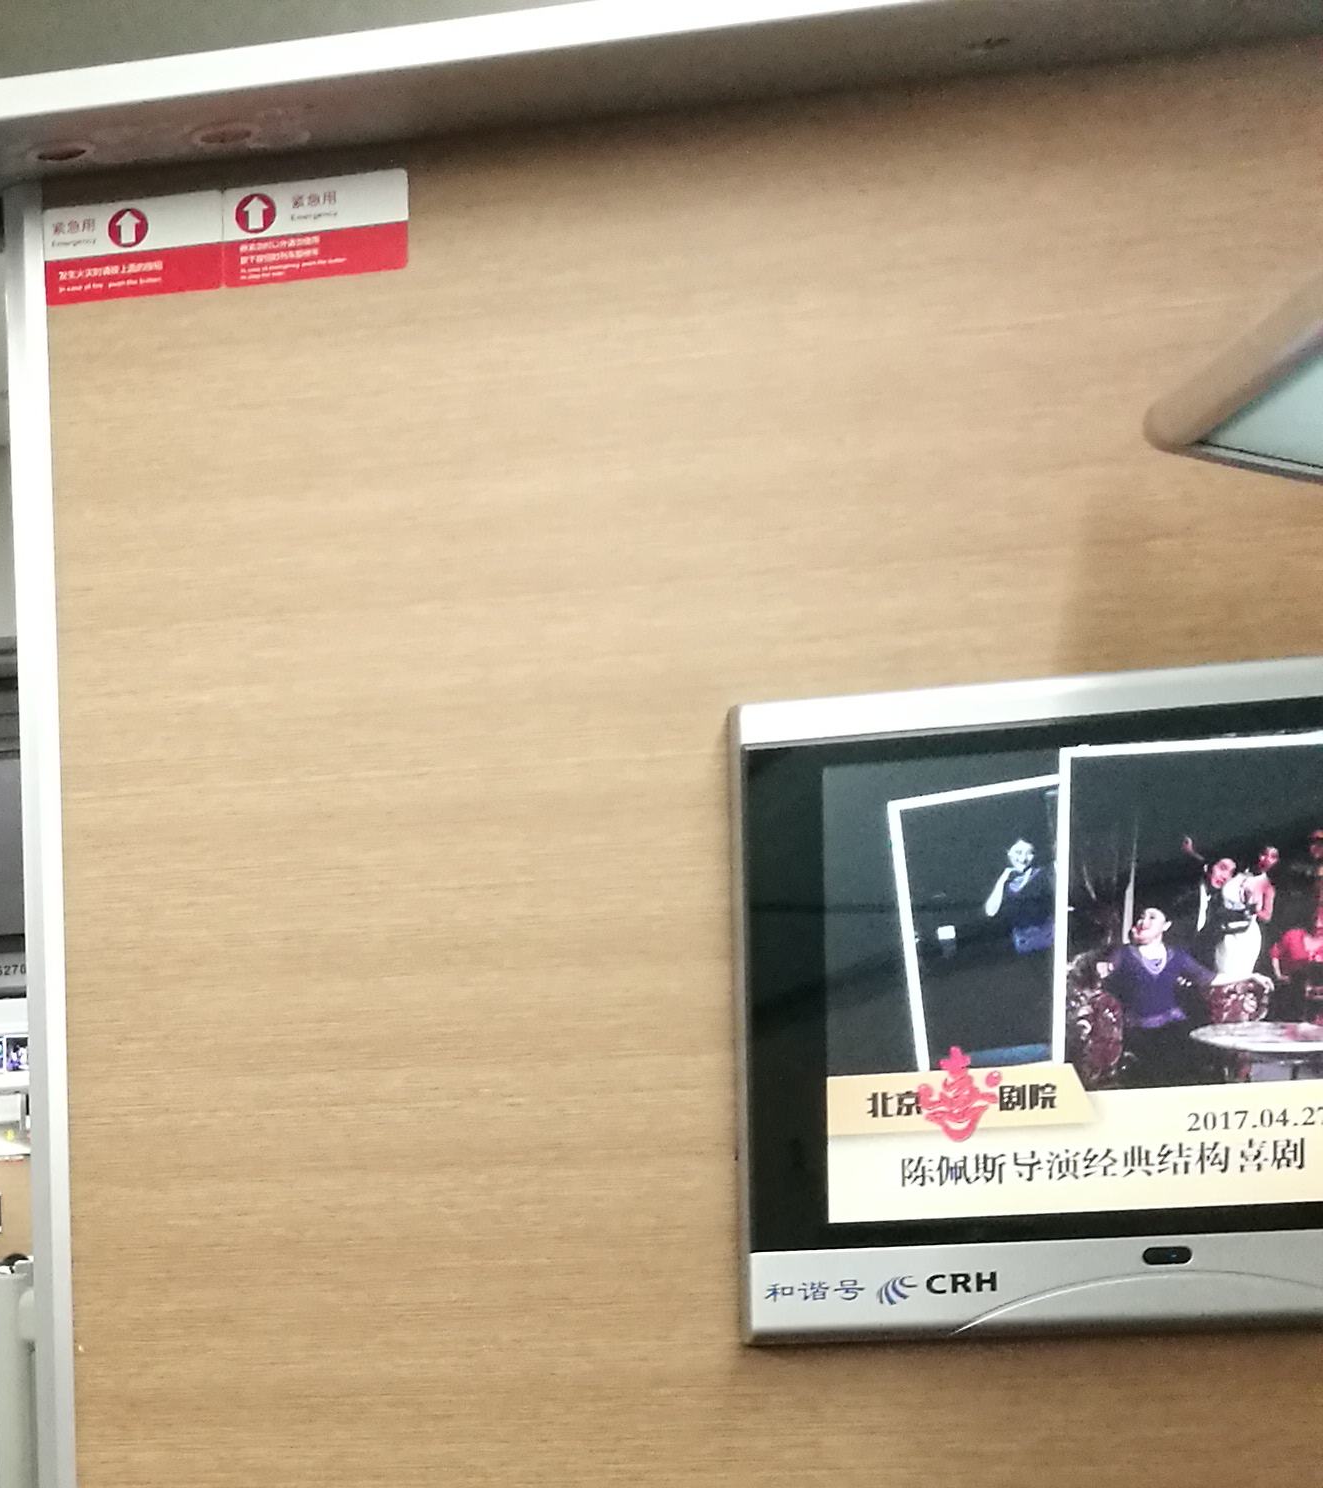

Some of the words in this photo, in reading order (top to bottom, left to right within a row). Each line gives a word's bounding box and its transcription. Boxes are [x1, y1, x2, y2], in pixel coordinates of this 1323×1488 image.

[764, 1279, 866, 1303] 和谐号
[925, 1271, 998, 1295] CRH
